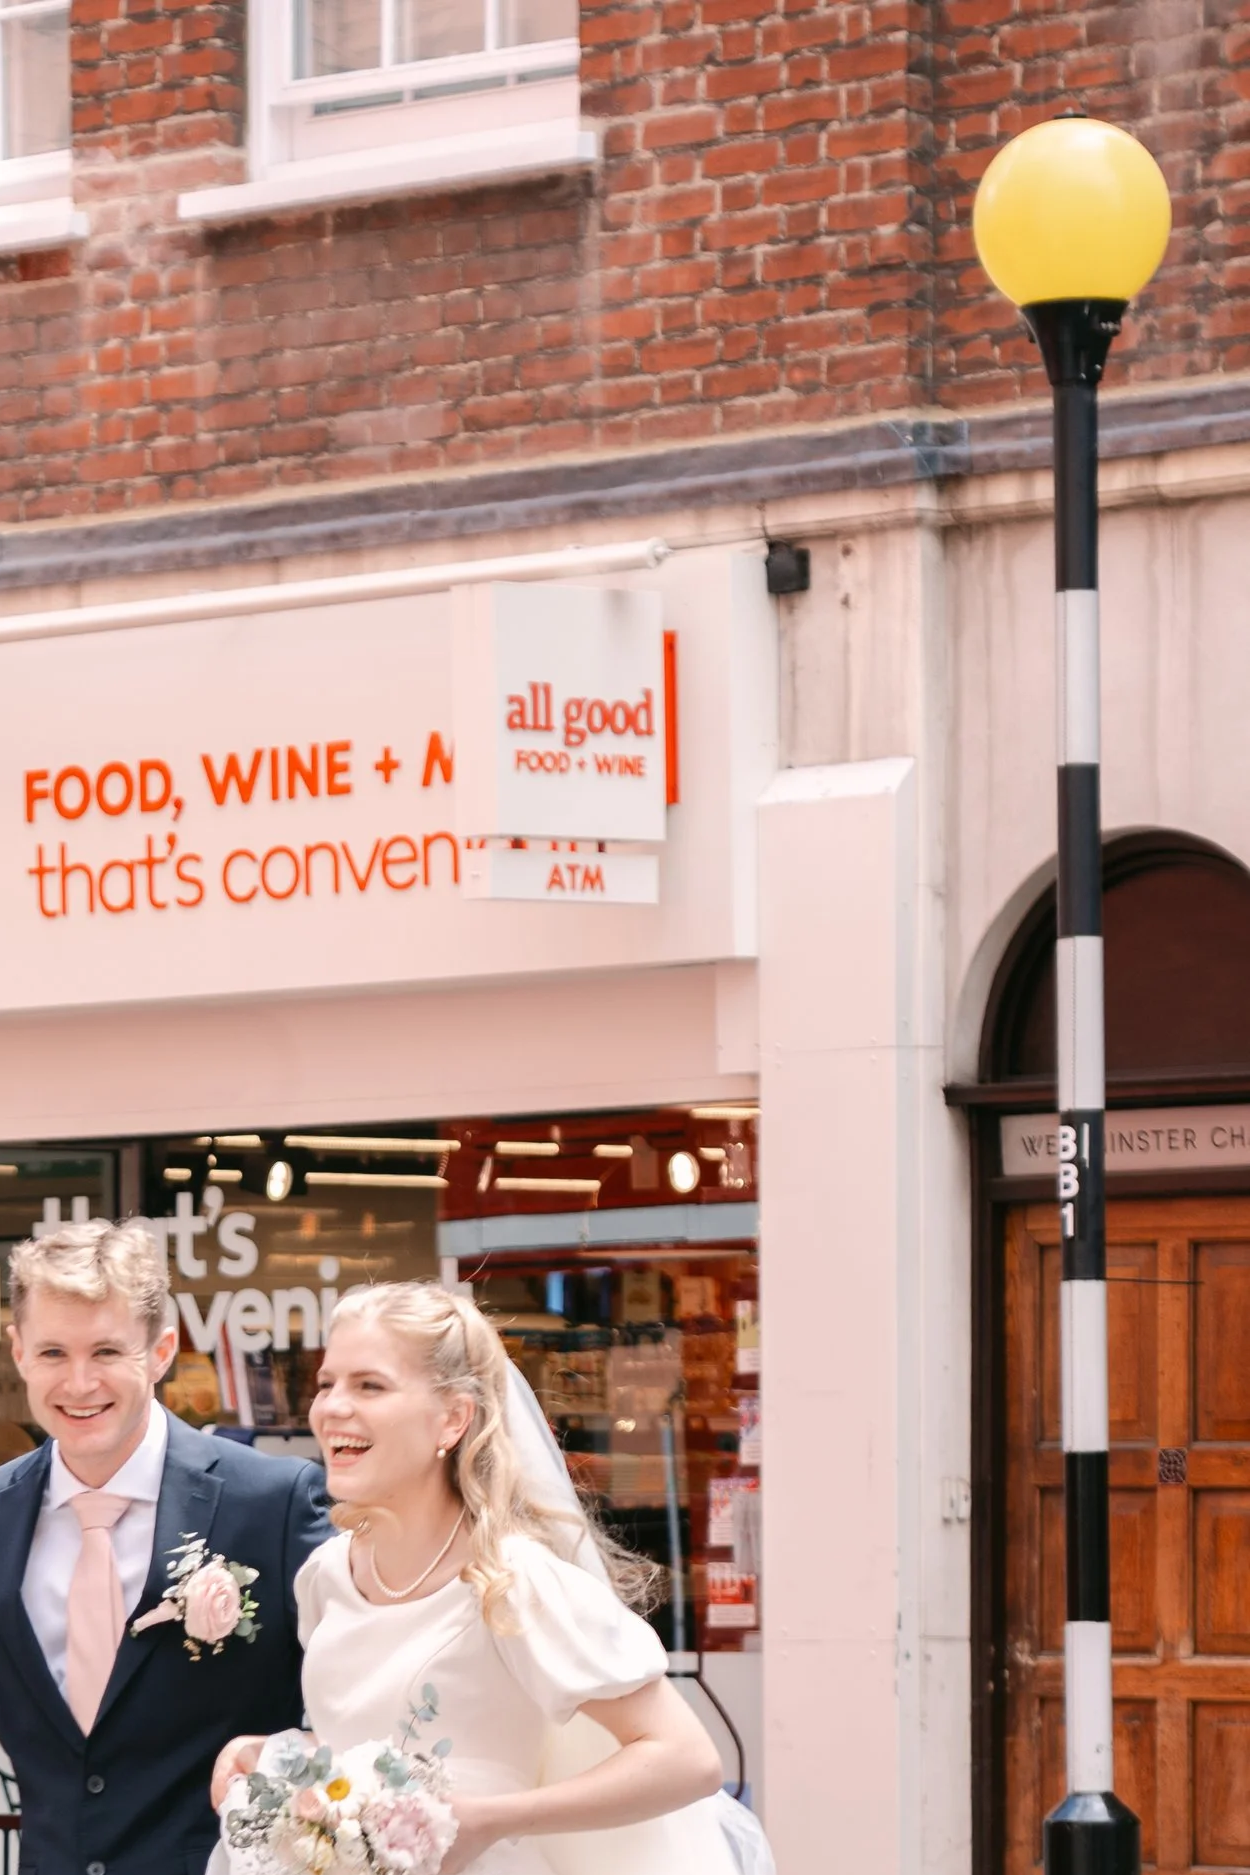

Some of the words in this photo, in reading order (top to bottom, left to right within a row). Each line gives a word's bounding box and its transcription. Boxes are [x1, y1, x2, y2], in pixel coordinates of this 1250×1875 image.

[506, 681, 554, 732] all
[563, 688, 655, 748] good
[24, 757, 184, 824] FOOD,
[201, 738, 354, 806] WINE
[514, 749, 570, 774] FOOD
[594, 753, 647, 777] WINE
[28, 831, 204, 919] that's
[222, 831, 462, 903] conven
[546, 863, 605, 893] ATM
[1021, 1129, 1198, 1158] WEINSTER
[1211, 1126, 1250, 1150] CH
